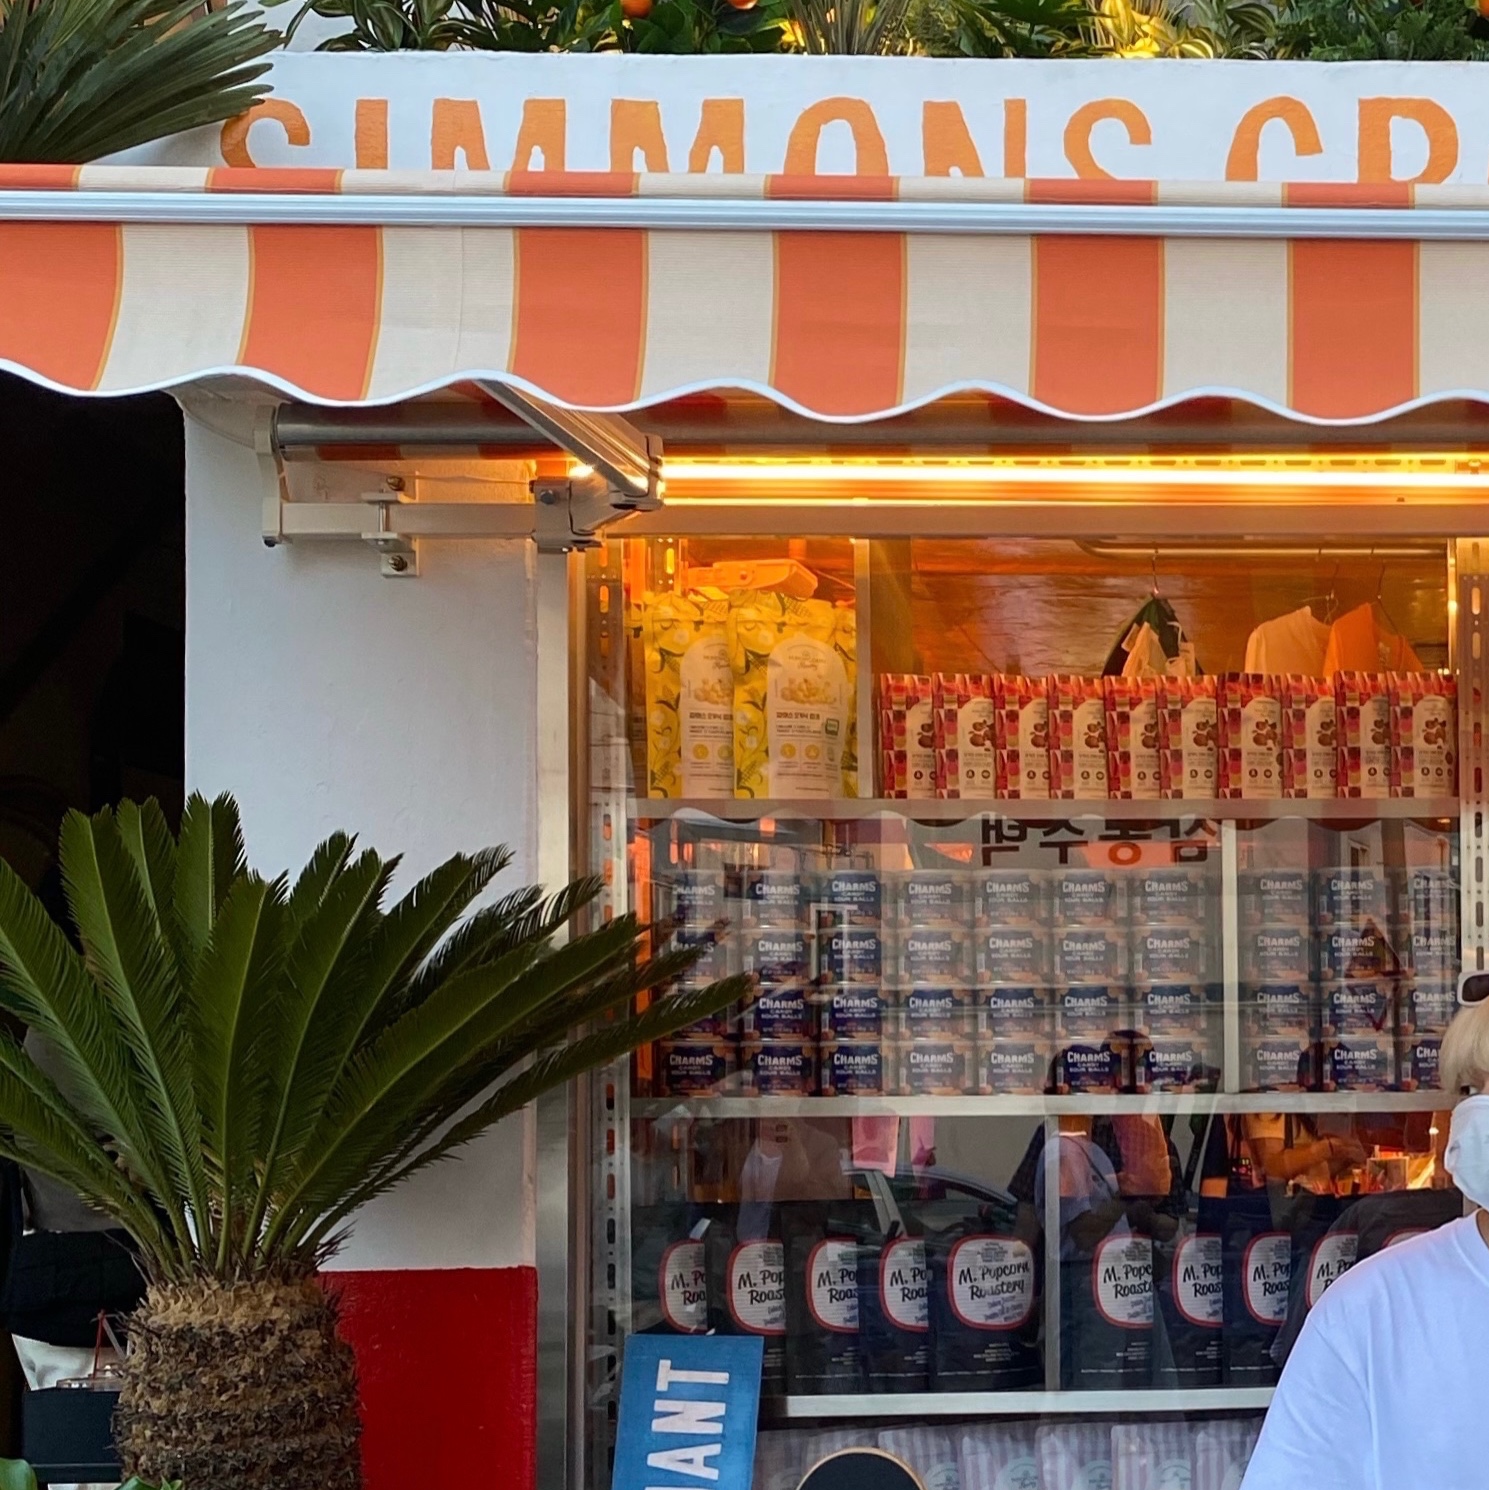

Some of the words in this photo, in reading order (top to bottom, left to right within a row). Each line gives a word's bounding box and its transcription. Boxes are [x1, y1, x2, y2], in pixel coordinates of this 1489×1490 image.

[755, 882, 801, 896] CHARMS
[831, 880, 877, 894] CHARMS
[908, 882, 952, 896] CHARMS
[985, 880, 1030, 894] CHARMS
[1062, 880, 1106, 894] CHARMS
[1144, 879, 1189, 893] CHARMS
[1259, 878, 1303, 892] CHARMS
[1330, 878, 1374, 892] CHARMS
[758, 940, 803, 953] CHARMS
[831, 937, 877, 951] CHARMS
[907, 939, 952, 952] CHARMS
[988, 937, 1034, 951] CHARMS
[1062, 939, 1107, 952] CHARMS
[1146, 937, 1190, 950] CHARMS
[1256, 935, 1301, 949] CHARMS
[1331, 935, 1376, 949] CHARMS
[1412, 935, 1457, 948] CHARMS
[759, 996, 804, 1011] CHARMS
[832, 996, 878, 1010] CHARMS
[908, 996, 953, 1010] CHARMS
[989, 996, 1035, 1010] CHARMS
[1064, 995, 1108, 1009] CHARMS
[1147, 993, 1192, 1007] CHARMS
[1256, 992, 1301, 1006] CHARMS
[1332, 992, 1377, 1006] CHARMS
[1412, 991, 1457, 1004] CHARMS
[669, 1053, 714, 1067] CHARMS
[756, 1053, 803, 1067] CHARMS
[833, 1052, 878, 1066] CHARMS
[909, 1051, 954, 1065] CHARMS
[990, 1051, 1035, 1065] CHARMS
[1066, 1050, 1111, 1064] CHARMS
[1148, 1050, 1193, 1064] CHARMS
[1256, 1049, 1301, 1063] CHARMS
[1333, 1048, 1377, 1062] CHARMS
[980, 1261, 1031, 1279] Popcorn
